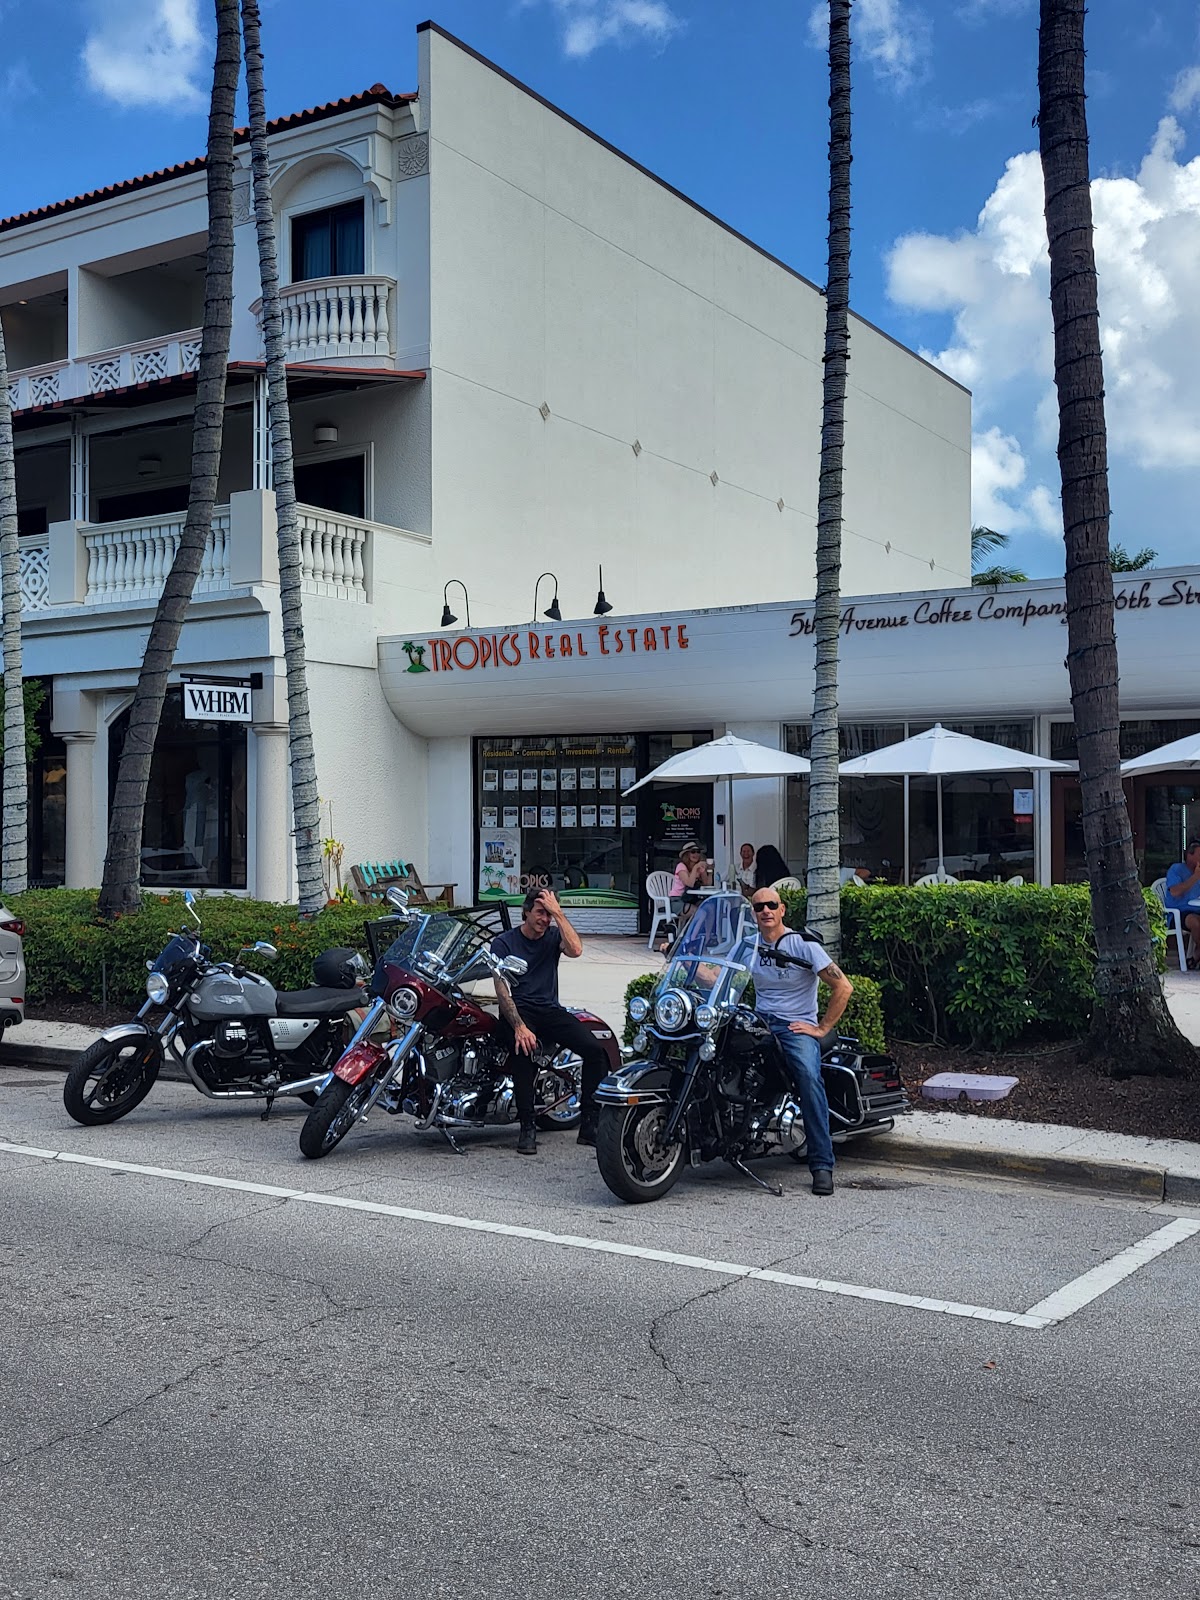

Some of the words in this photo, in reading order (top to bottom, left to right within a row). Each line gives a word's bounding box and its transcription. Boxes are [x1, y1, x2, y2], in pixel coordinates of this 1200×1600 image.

[838, 606, 909, 635] Avenue
[913, 598, 973, 626] Coffee
[1114, 581, 1152, 610] 6th
[427, 632, 522, 672] TROPICS
[187, 688, 249, 714] WHBM
[482, 749, 515, 758] Residential
[521, 748, 557, 757] Commercial
[565, 747, 599, 756] Investment
[607, 746, 631, 755] Rentals
[1123, 744, 1146, 755] 599
[676, 807, 701, 820] TROPICS
[506, 874, 549, 893] TROPICS
